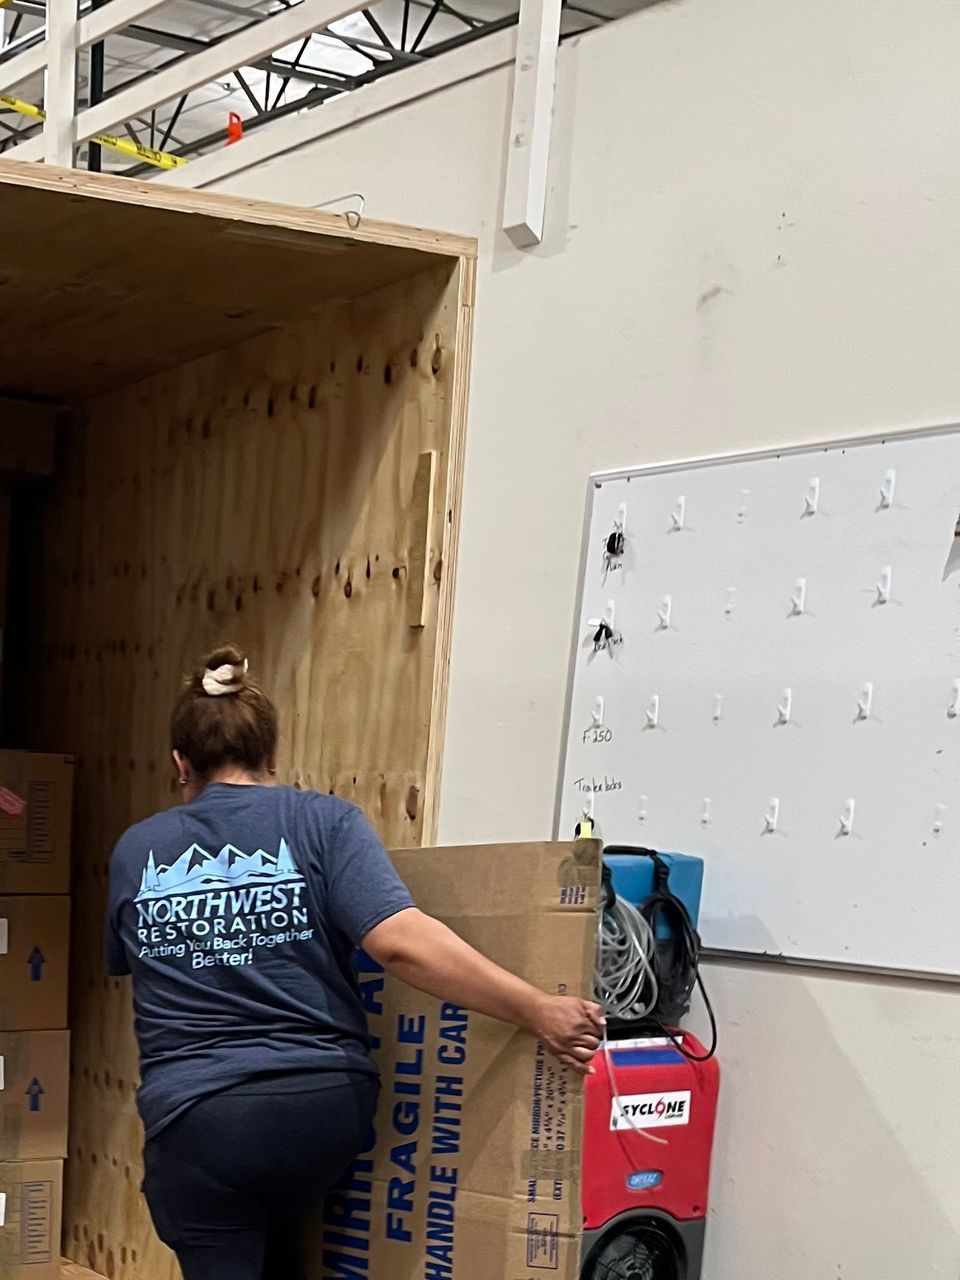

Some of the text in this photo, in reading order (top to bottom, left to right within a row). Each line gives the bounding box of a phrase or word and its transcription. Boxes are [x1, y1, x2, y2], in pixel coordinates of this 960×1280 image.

[582, 728, 612, 744] F-250
[136, 882, 306, 927] NORTHWEST
[138, 908, 308, 944] RESTORATION
[139, 928, 315, 958] Putting You Back Together
[191, 949, 253, 970] Better!
[437, 1000, 470, 1066] CAR
[386, 1013, 426, 1243] FRAGILE
[431, 1075, 464, 1155] WITH
